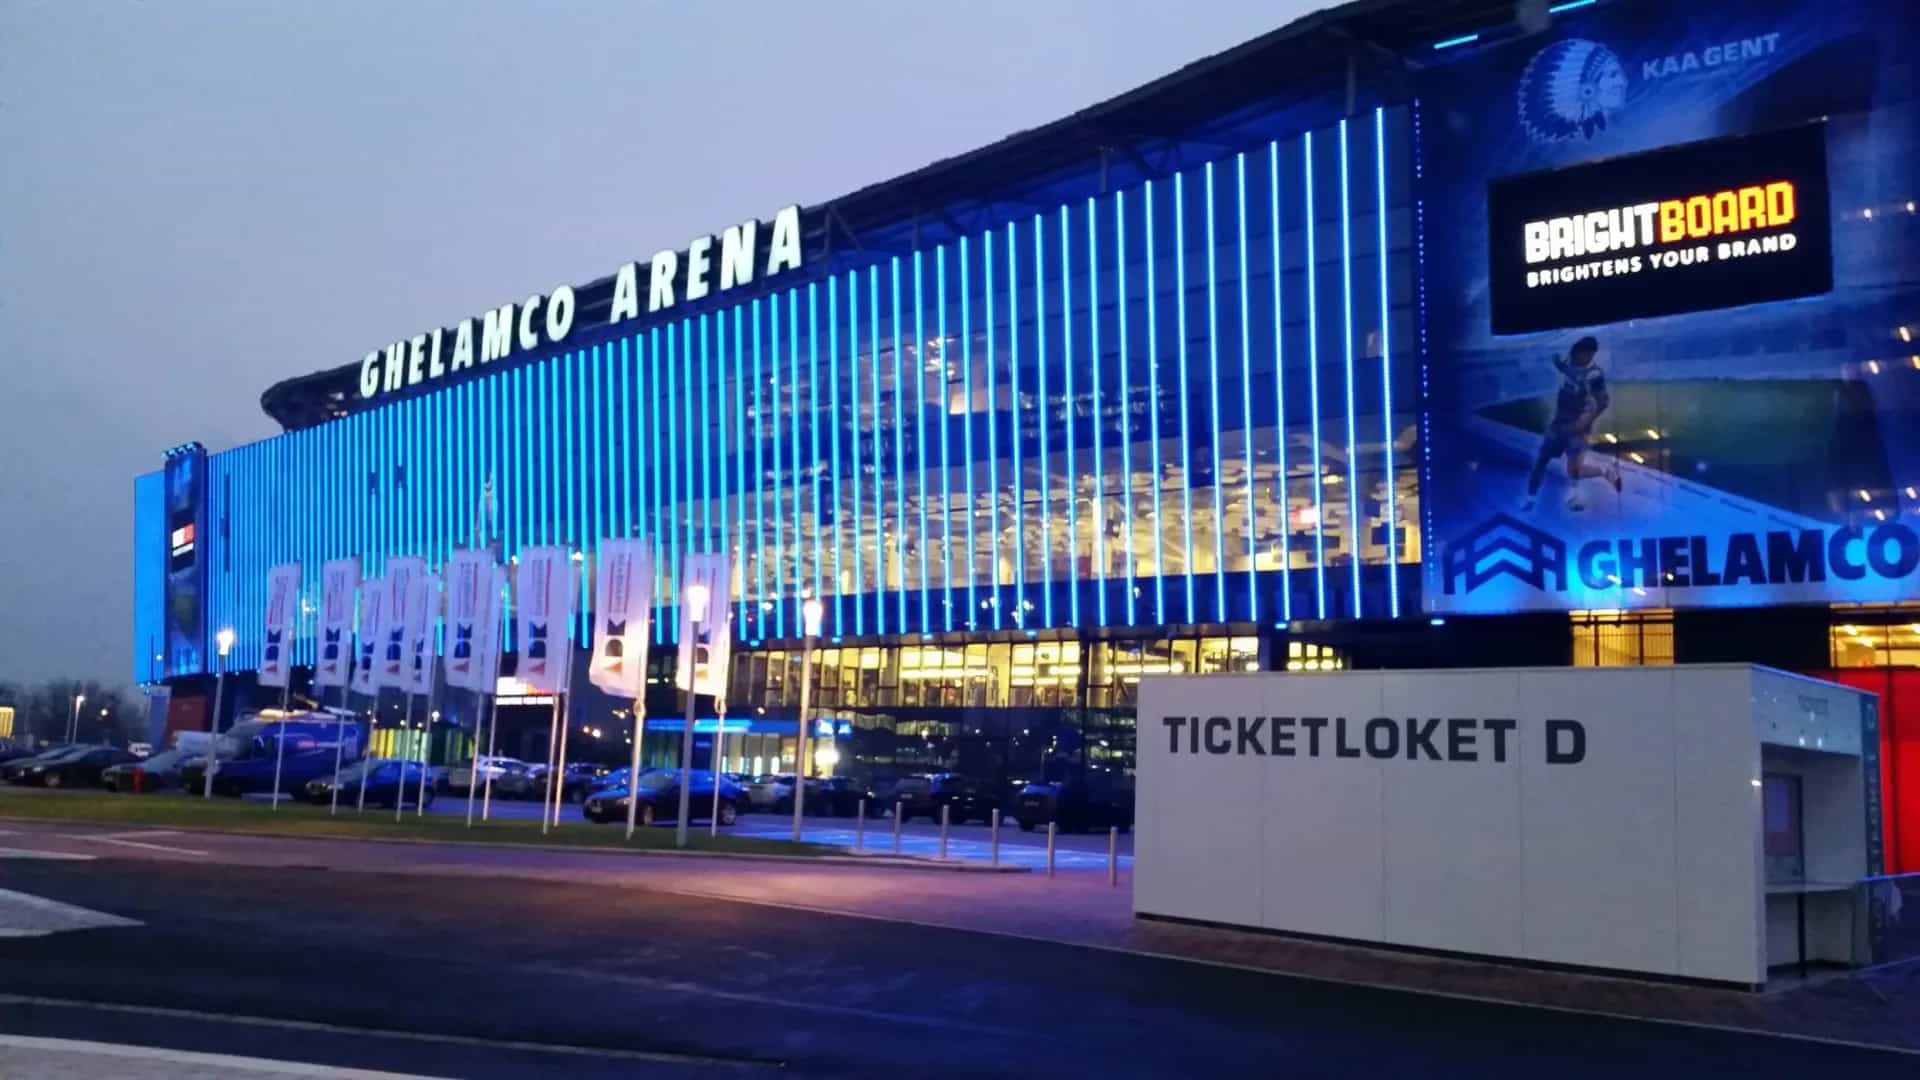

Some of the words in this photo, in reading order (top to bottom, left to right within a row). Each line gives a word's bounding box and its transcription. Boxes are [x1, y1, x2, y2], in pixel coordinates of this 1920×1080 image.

[1641, 53, 1699, 80] KAA
[1704, 32, 1781, 67] GENT
[1524, 181, 1795, 263] BRIGHTBOARD
[1526, 256, 1643, 288] BRIGHTENS
[1649, 246, 1709, 271] YOUR
[1717, 233, 1797, 260] BRAND
[360, 284, 576, 399] GHELAMCO
[610, 204, 802, 324] ARENA
[1577, 521, 1920, 591] GHELAMCO
[1162, 716, 1517, 763] TICKETLOKET
[1545, 719, 1587, 765] D
